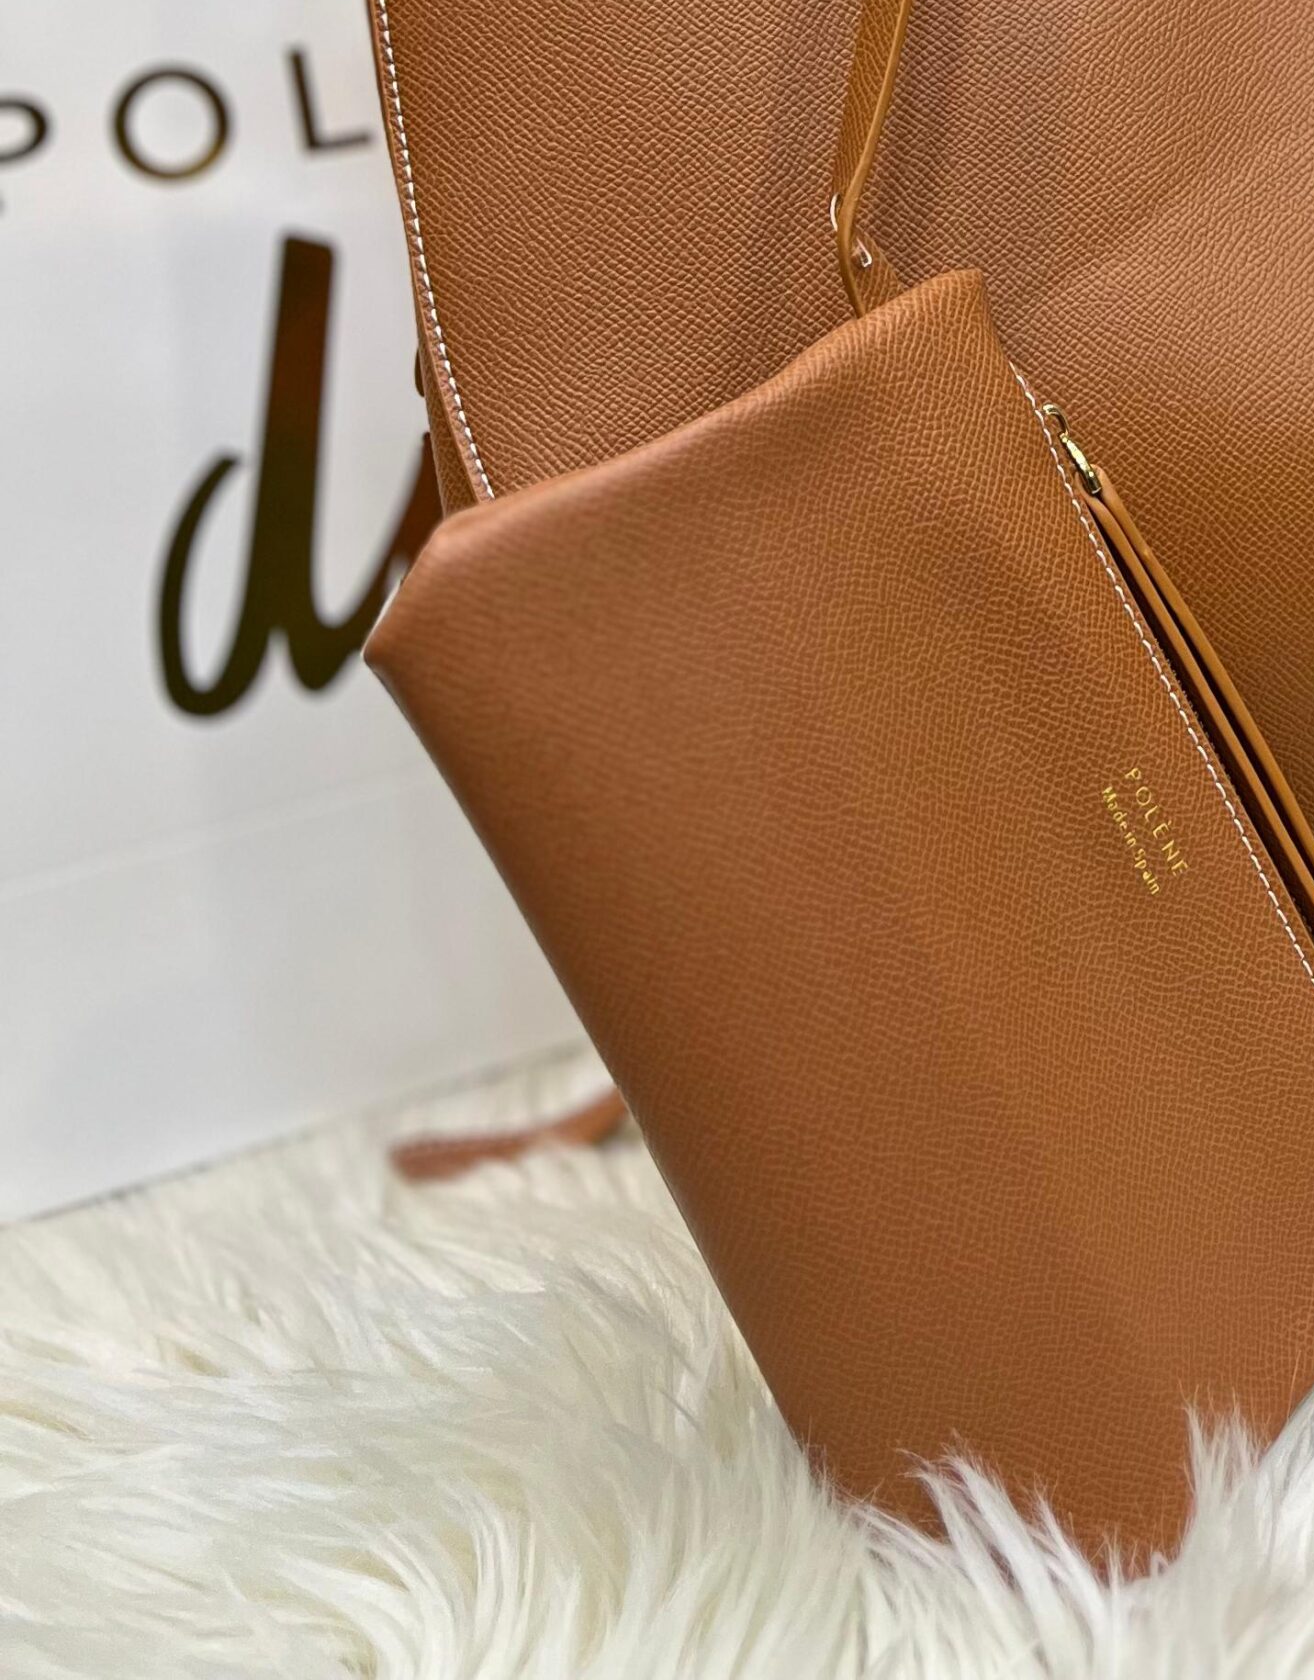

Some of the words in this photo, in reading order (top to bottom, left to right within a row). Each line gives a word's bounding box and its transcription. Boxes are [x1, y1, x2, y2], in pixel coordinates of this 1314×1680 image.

[1102, 786, 1128, 832] Made
[1124, 830, 1137, 848] in
[1134, 848, 1161, 896] Spain
[1125, 767, 1189, 877] POLÈNE
